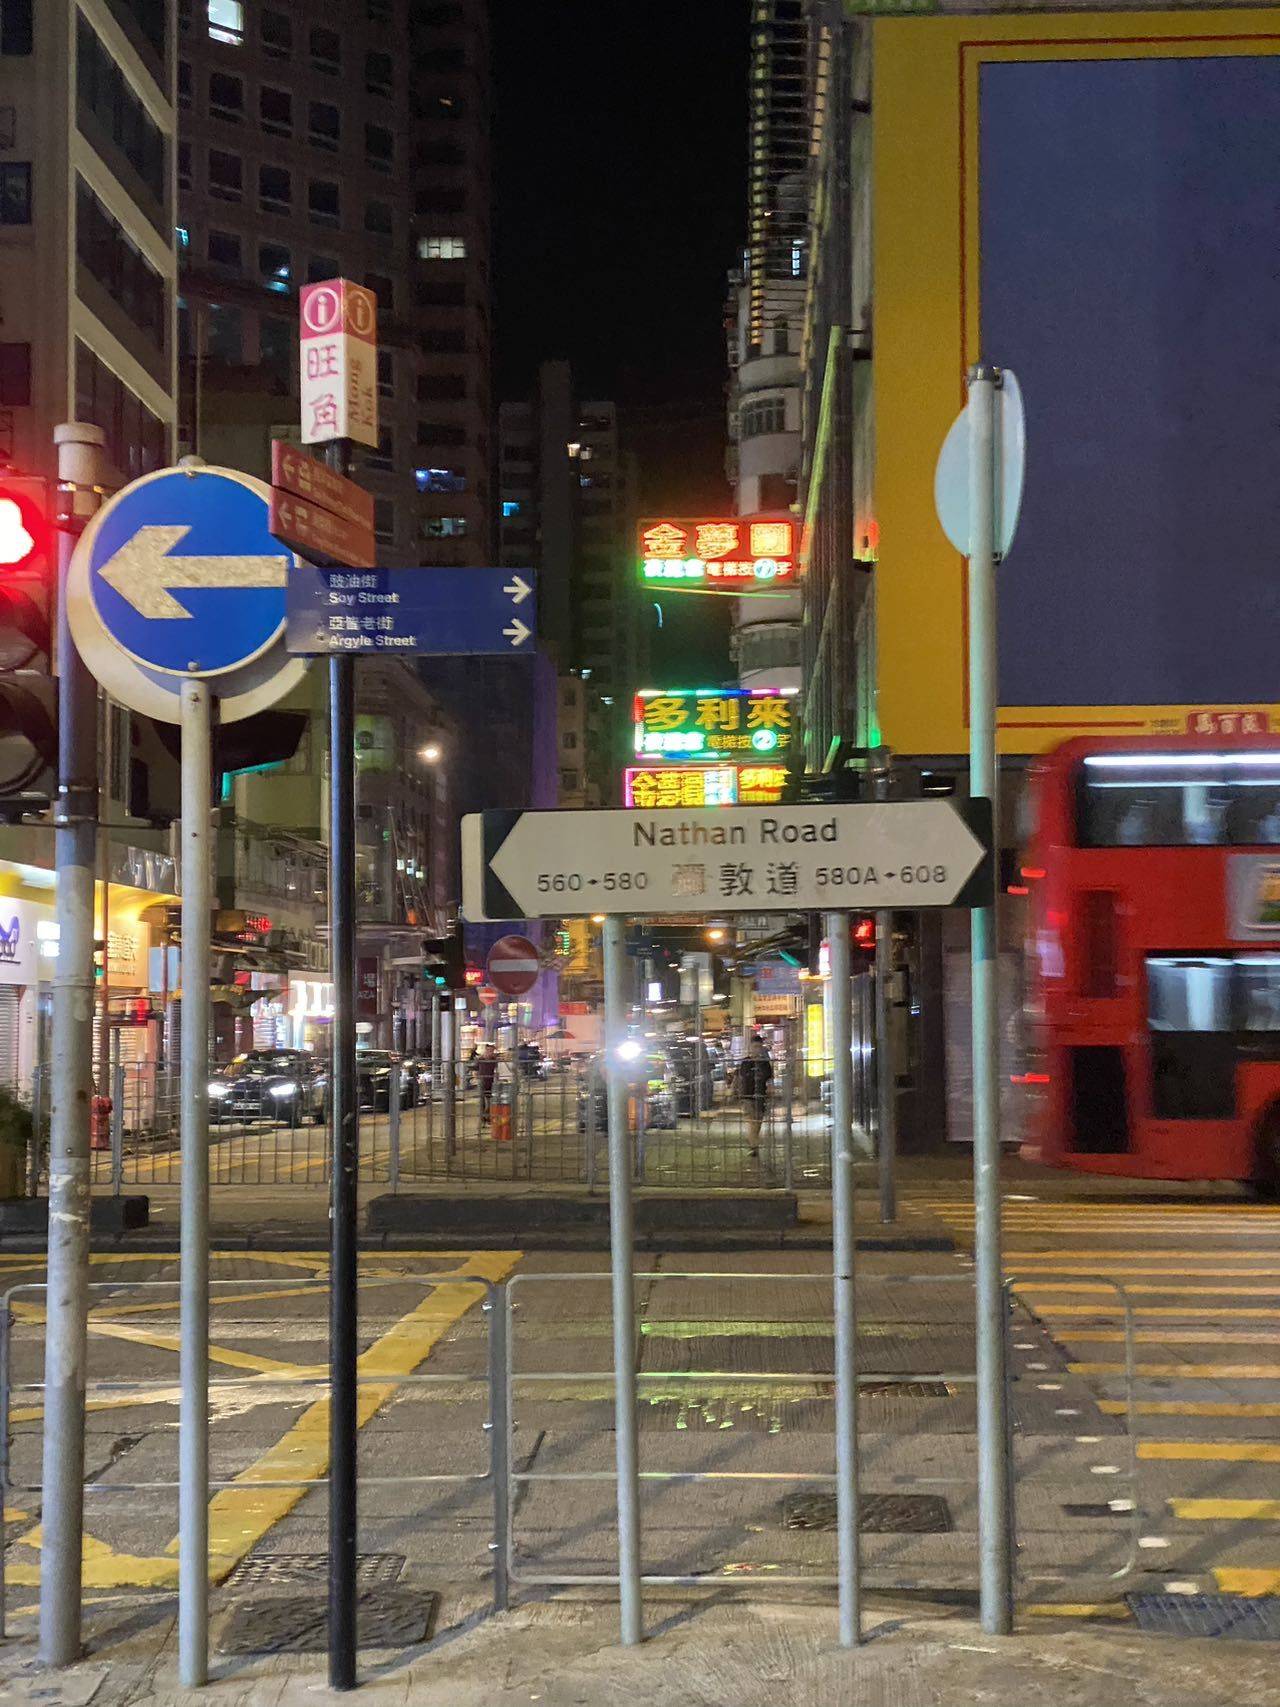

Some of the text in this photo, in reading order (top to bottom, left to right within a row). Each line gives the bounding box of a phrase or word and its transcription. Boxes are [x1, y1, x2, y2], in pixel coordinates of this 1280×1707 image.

[307, 344, 339, 437] 旺角
[350, 359, 362, 422] Mong
[329, 592, 399, 605] Soy Street
[329, 634, 417, 649] Argyle Street
[644, 696, 791, 731] 多利來
[633, 817, 838, 846] Nathan Road
[537, 871, 648, 892] 560 580
[815, 864, 948, 886] 580A 608
